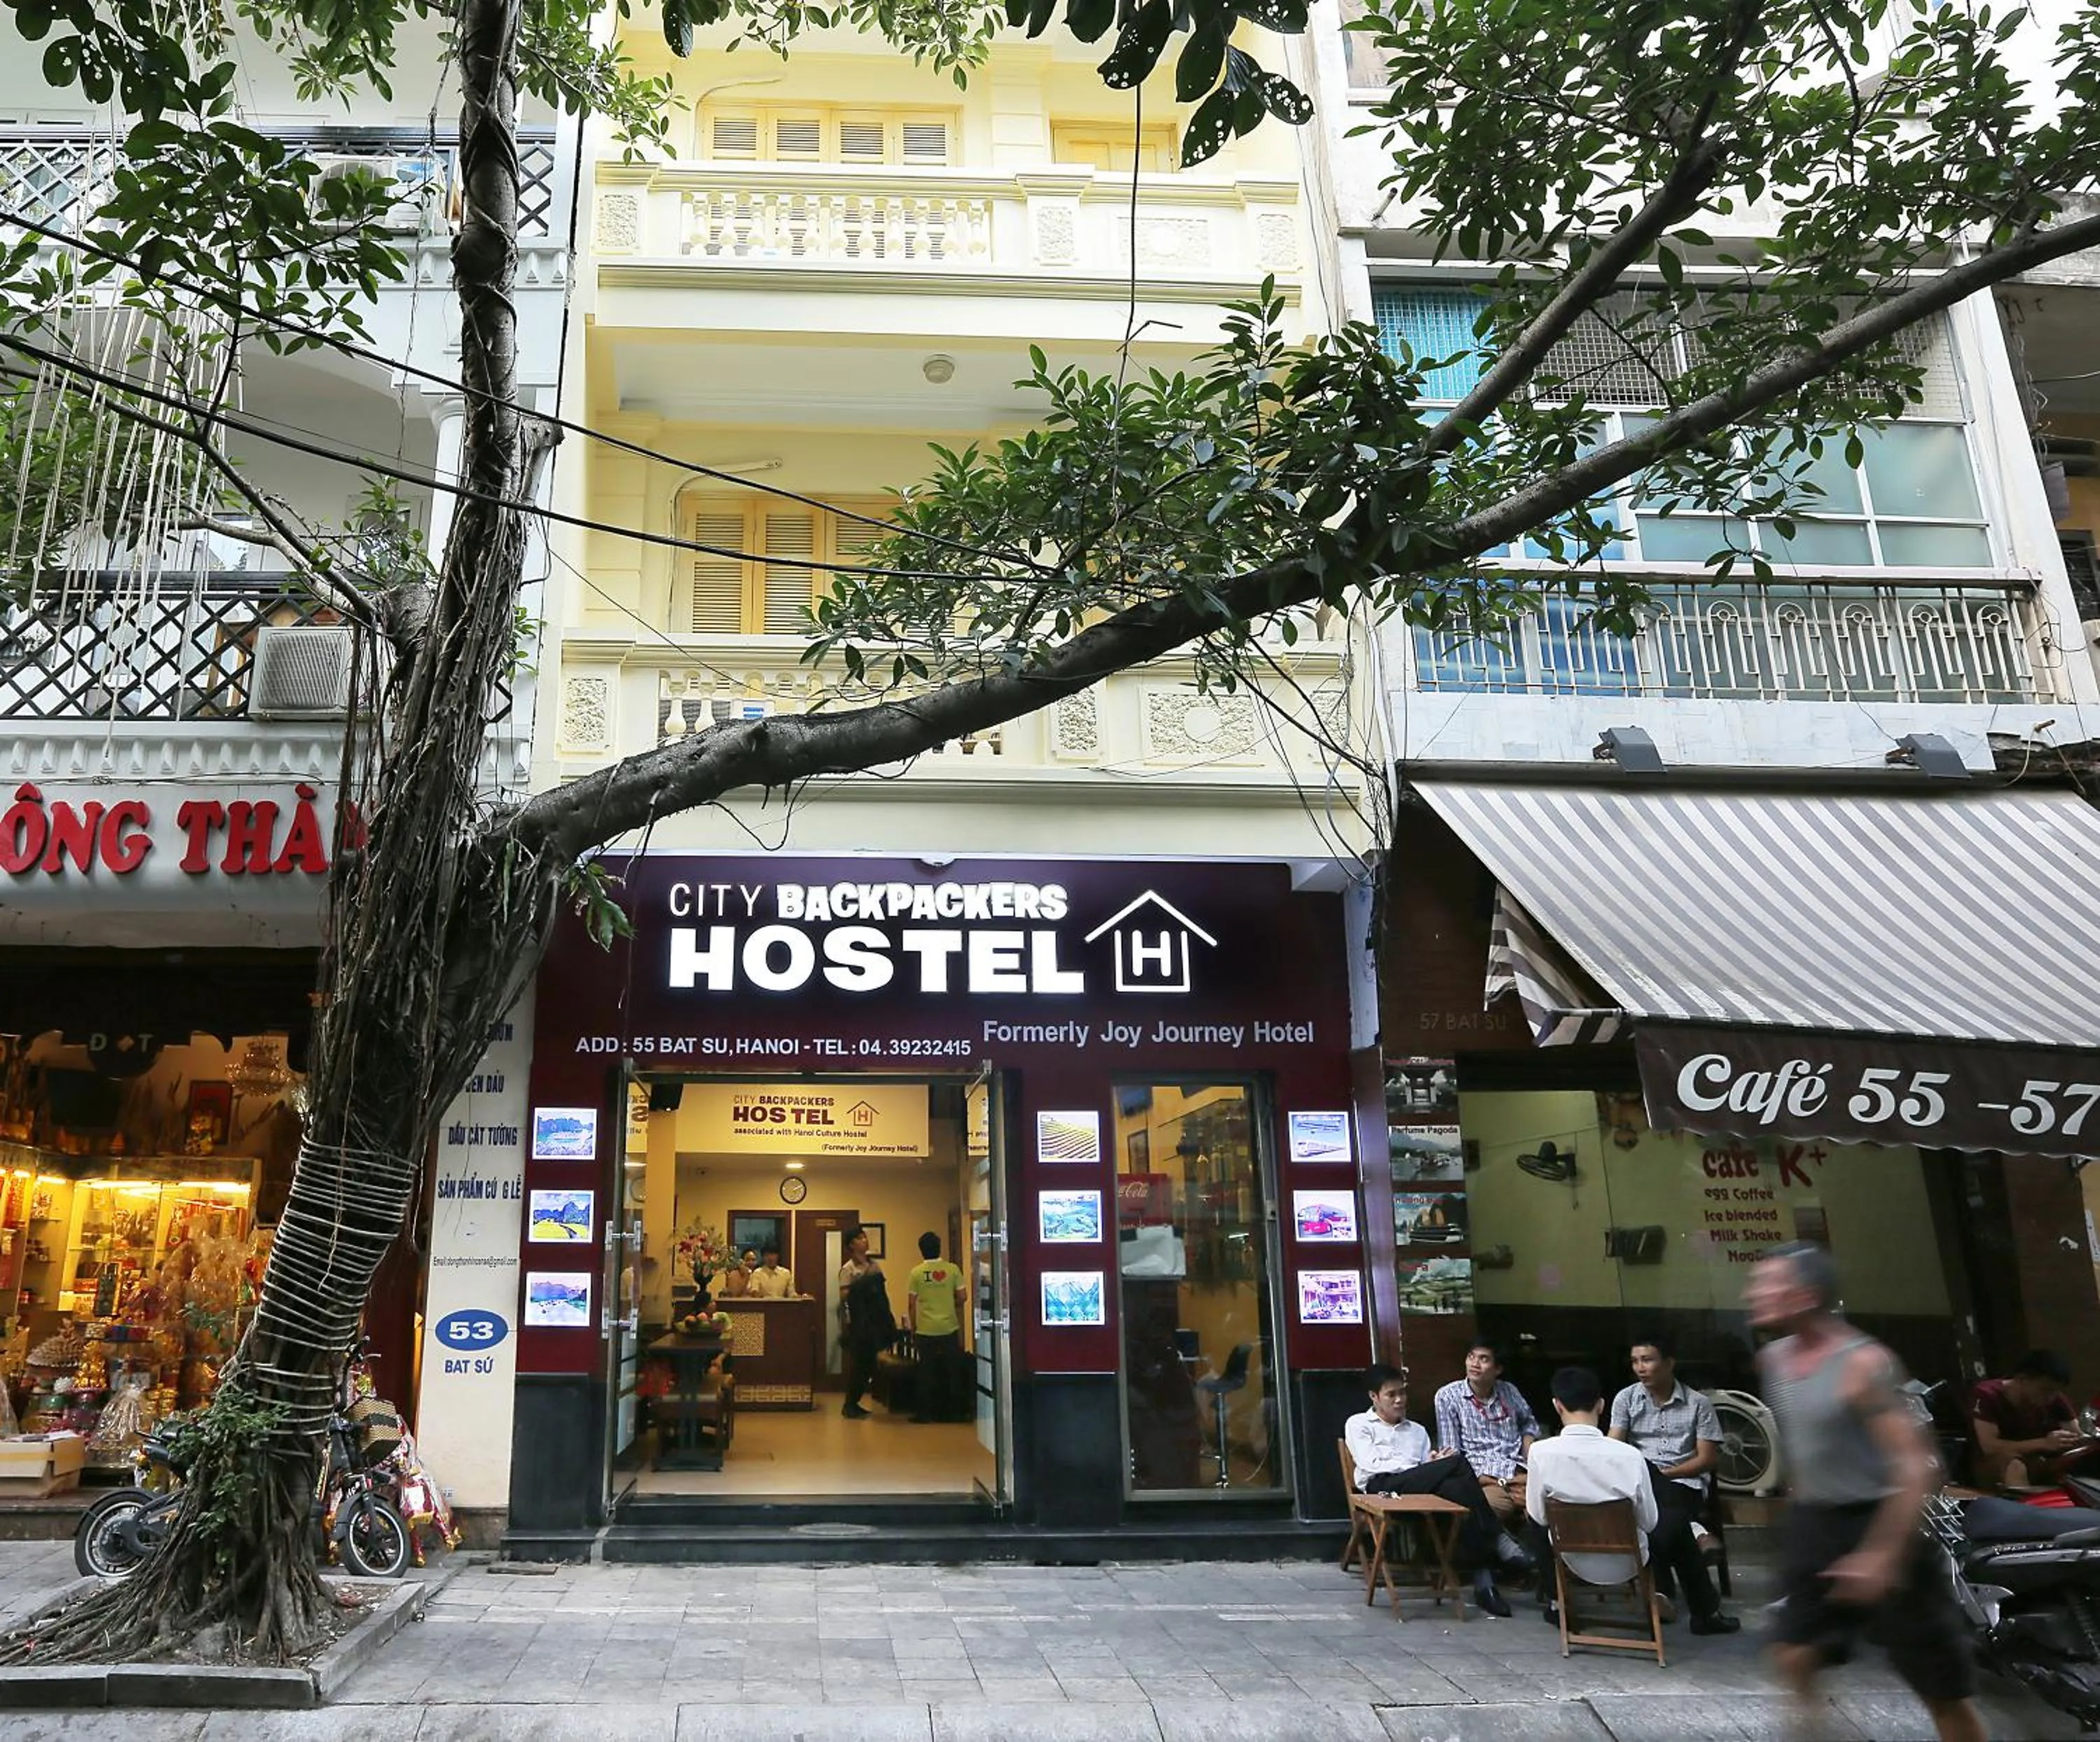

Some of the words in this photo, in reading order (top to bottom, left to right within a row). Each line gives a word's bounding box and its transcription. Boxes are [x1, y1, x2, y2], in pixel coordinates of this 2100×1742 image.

[669, 883, 762, 917] CITY
[776, 882, 1068, 922] BACKPACKERS
[668, 925, 1085, 994] HOSTEL
[1420, 1012, 1439, 1030] 57
[983, 1020, 1089, 1048] Formerly
[1100, 1020, 1142, 1048] Joy
[1152, 1021, 1244, 1048] Journey
[1254, 1022, 1314, 1043] Hotel
[632, 1037, 654, 1052] 55
[659, 1037, 697, 1053] BAT
[1676, 1054, 1833, 1125] Café
[1848, 1067, 1951, 1127] 55
[733, 1094, 756, 1104] CITY
[759, 1096, 835, 1106] BACKPACKERS
[732, 1106, 835, 1125] HOSTEL
[1391, 1126, 1425, 1134] Perfume
[1427, 1127, 1458, 1136] Pagoda
[1704, 1189, 1730, 1201] egg
[1732, 1187, 1774, 1200] Coffee
[1704, 1210, 1723, 1222] Ice
[1725, 1208, 1779, 1222] blended
[1710, 1229, 1739, 1242] Milk
[1742, 1228, 1782, 1241] Shake
[449, 1321, 493, 1339] 53
